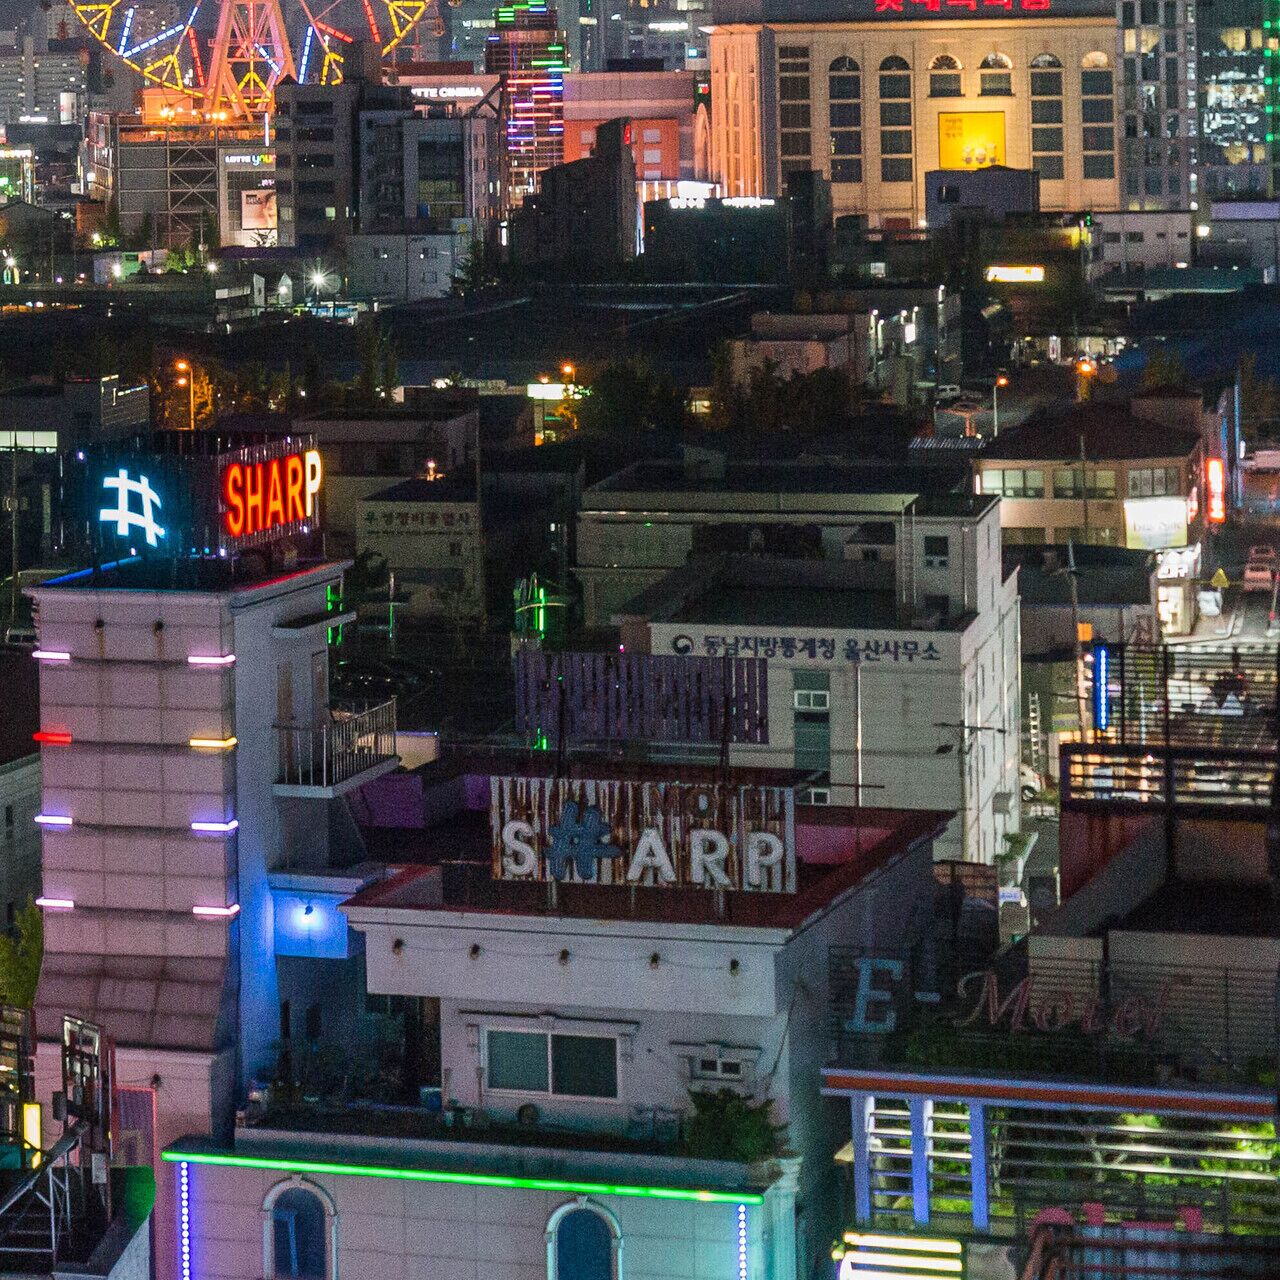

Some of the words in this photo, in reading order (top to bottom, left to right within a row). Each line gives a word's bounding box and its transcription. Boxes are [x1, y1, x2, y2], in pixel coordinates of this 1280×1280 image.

[226, 450, 322, 538] SHARP
[703, 634, 836, 659] 동남지방통계청
[843, 638, 940, 661] 울산사무소
